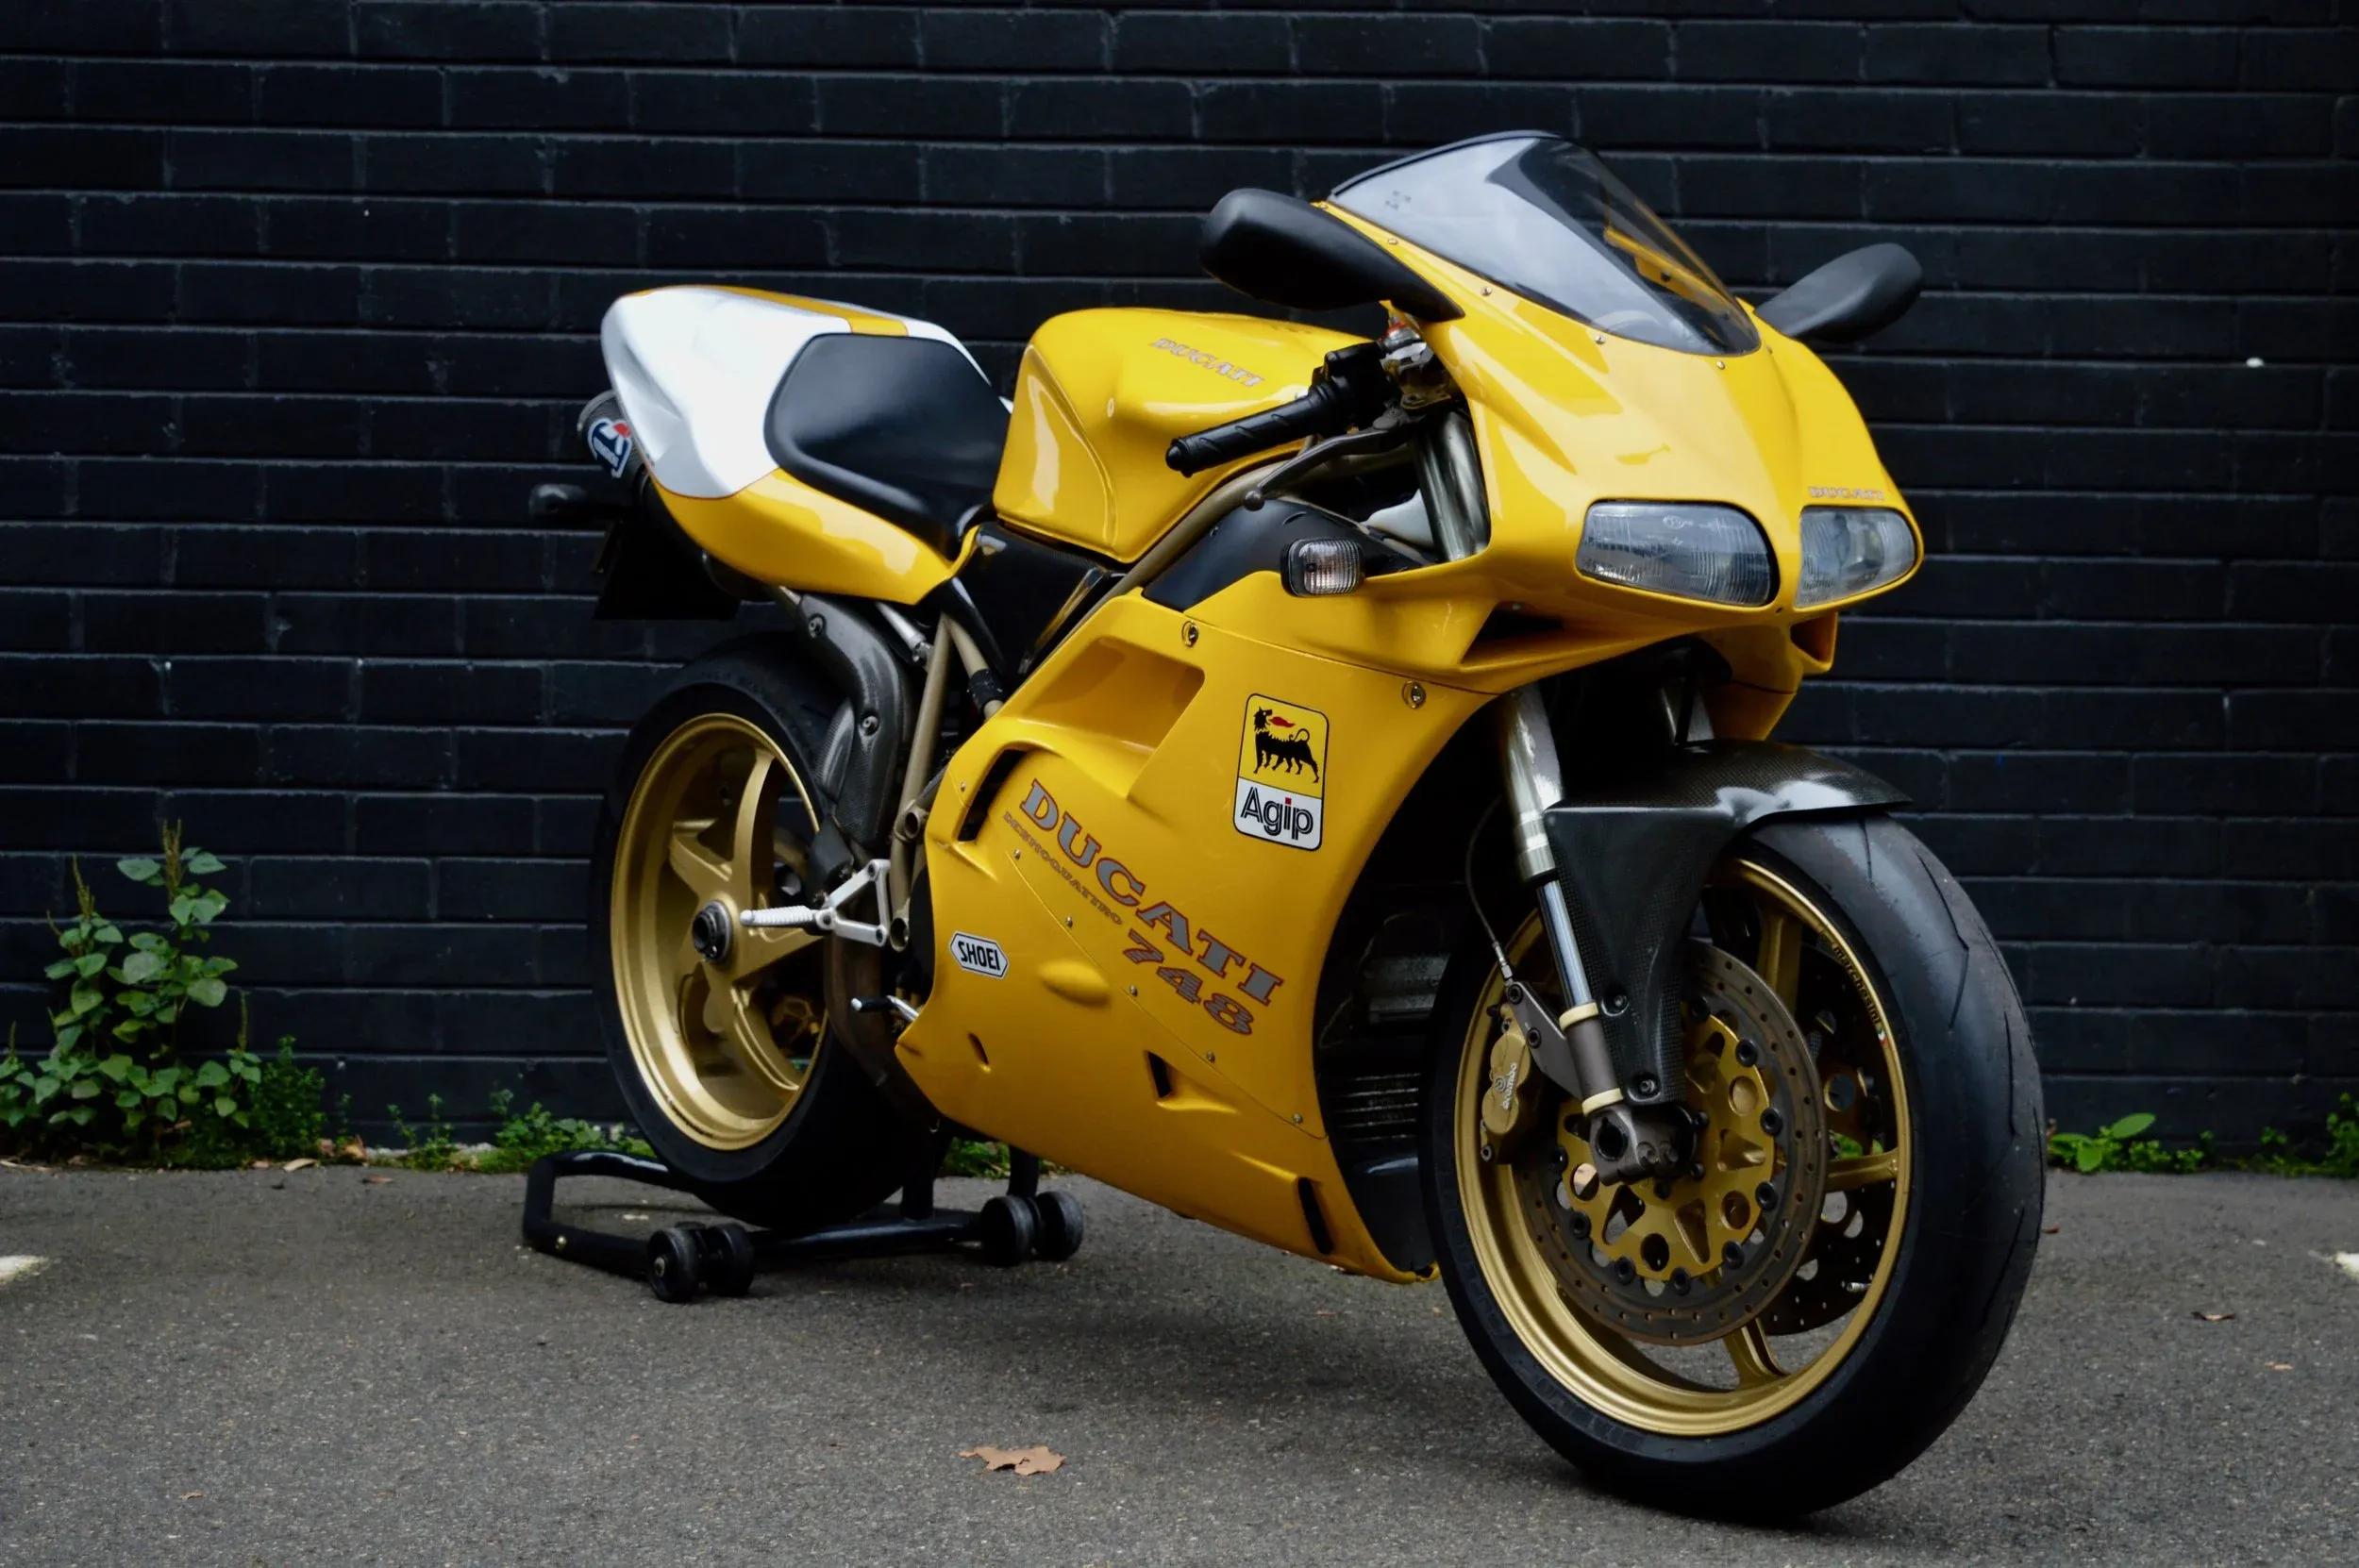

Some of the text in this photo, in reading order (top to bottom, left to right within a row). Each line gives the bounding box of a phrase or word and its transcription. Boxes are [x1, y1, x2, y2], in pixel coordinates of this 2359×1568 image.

[1149, 338, 1264, 387] DUCATI
[1808, 486, 1884, 502] DUCATI
[1240, 786, 1313, 841] Agip
[1002, 810, 1123, 926] DESMOQUATTRO
[1019, 778, 1284, 1007] DUCATI
[958, 941, 1000, 971] SHOEI
[1122, 927, 1254, 1035] 748
